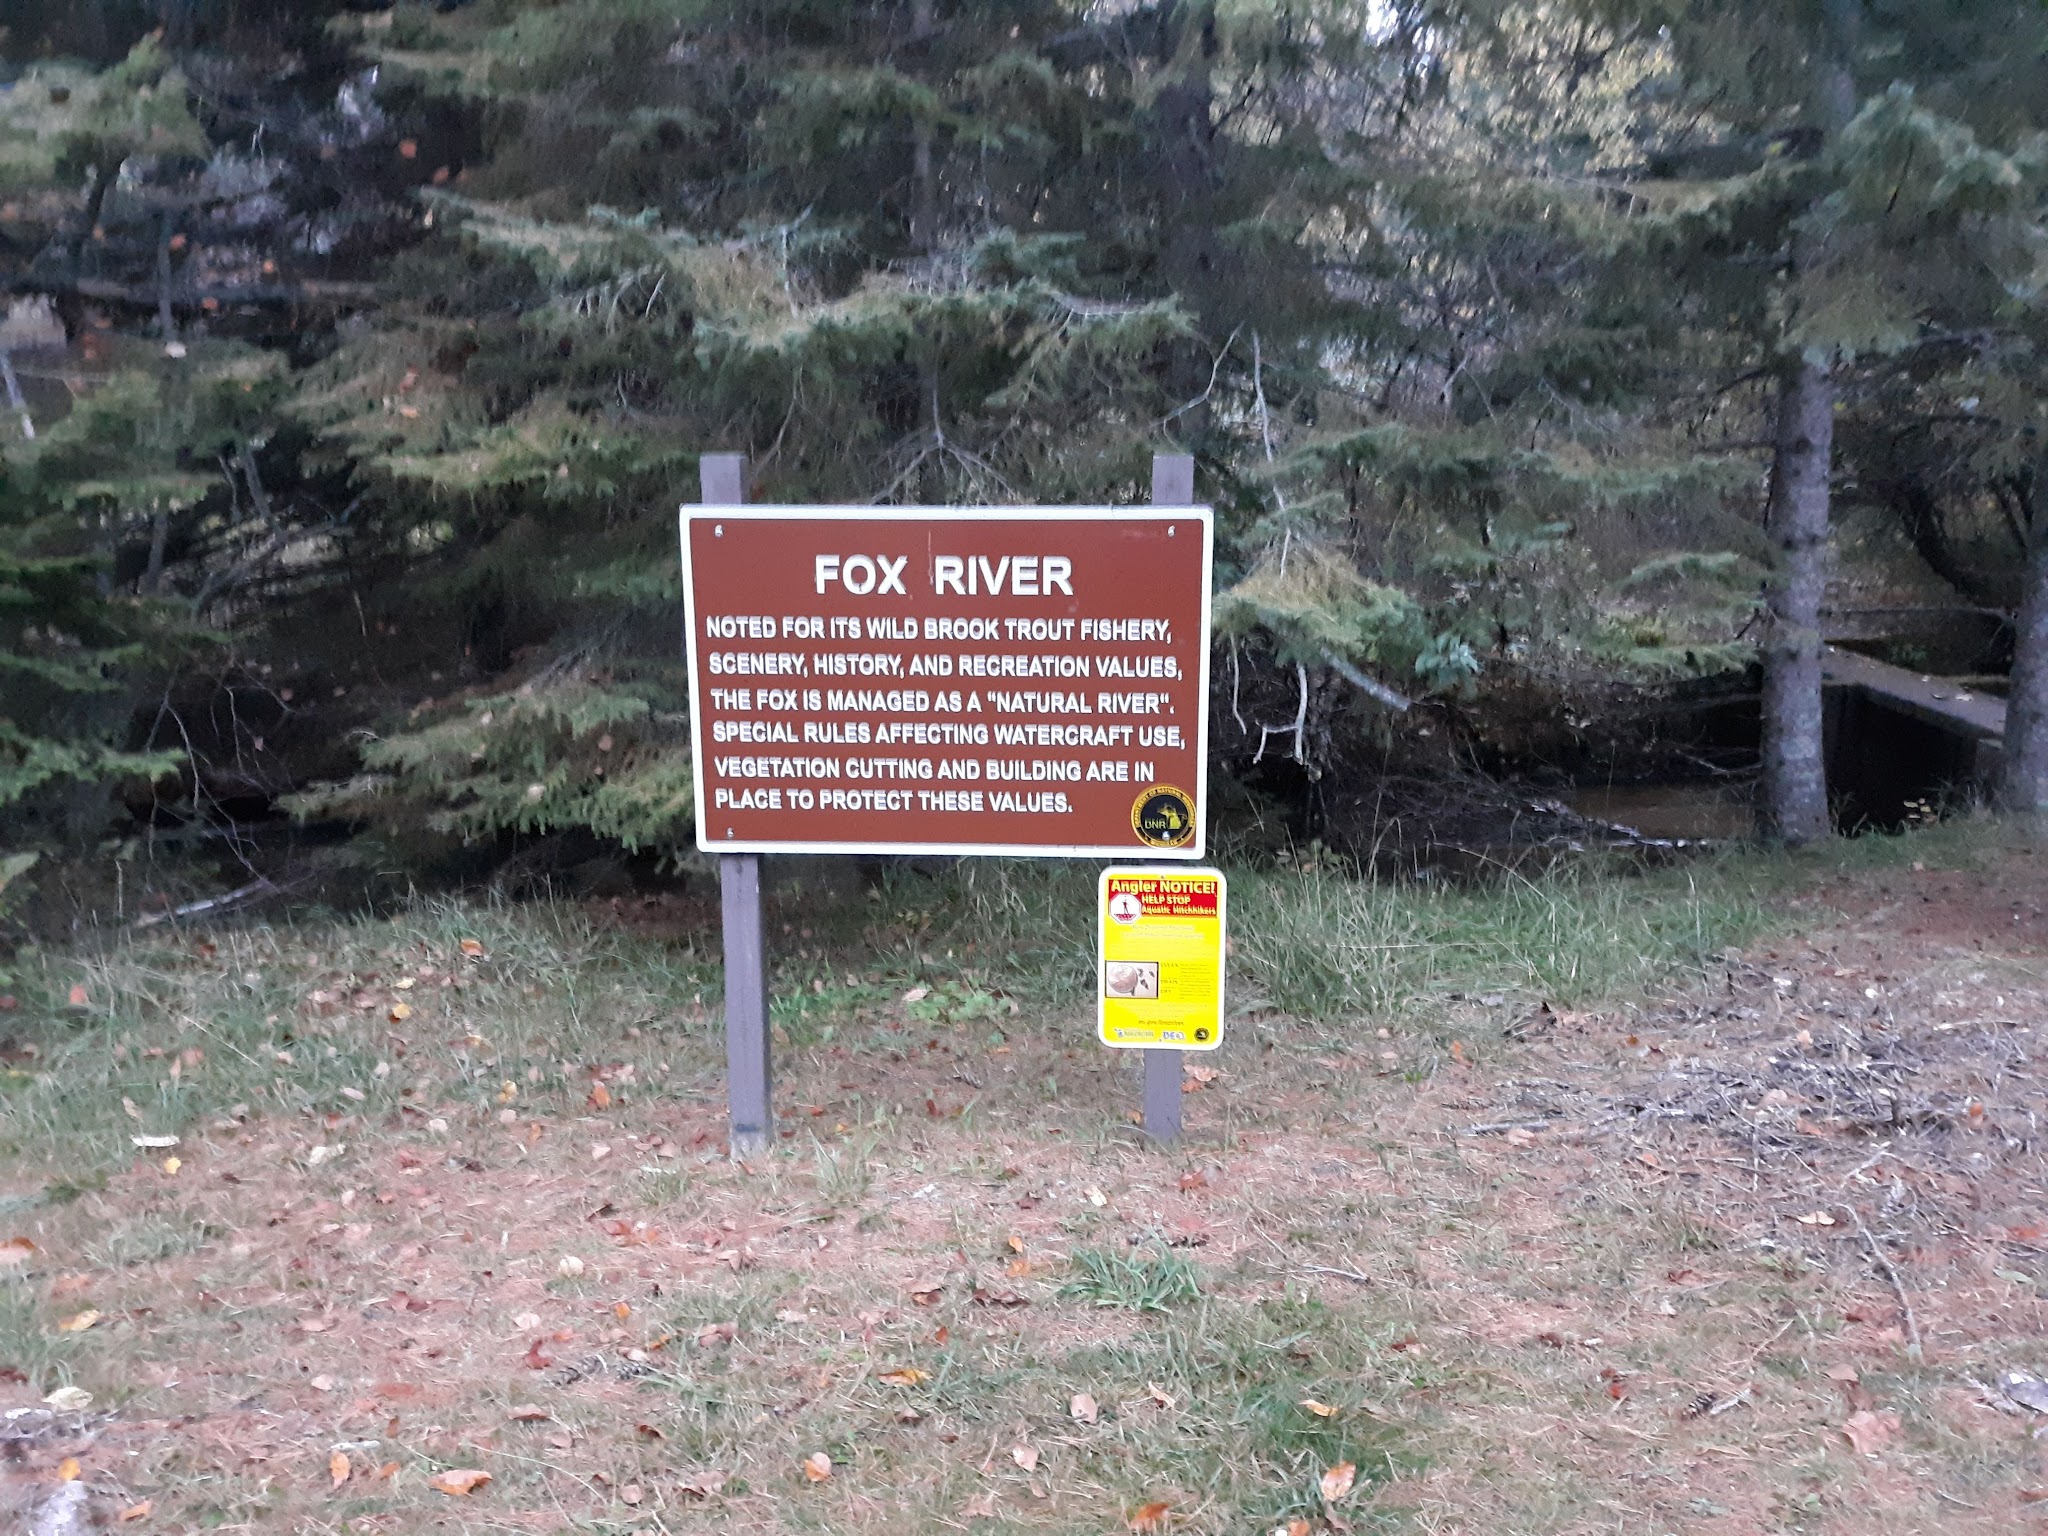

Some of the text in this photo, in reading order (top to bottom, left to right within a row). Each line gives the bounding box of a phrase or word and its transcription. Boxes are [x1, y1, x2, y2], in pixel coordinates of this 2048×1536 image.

[815, 555, 1073, 596] FOX RIVER
[707, 616, 1171, 644] NOTED FOR ITS WILD BROOK TROUT FISHERY,
[710, 652, 1182, 681] SCENERY, HISTORY, AND RECREATION VALUES,
[711, 689, 751, 710] THE
[757, 689, 798, 710] FOX
[803, 689, 821, 710] IS
[828, 690, 929, 711] MANAGED
[934, 691, 962, 712] AS
[967, 691, 982, 712] A
[987, 691, 1092, 713] "NATURAL
[713, 721, 1185, 750] SPECIAL RULES AFFECTING WATERCRAFT USE,
[714, 756, 1154, 782] VEGETATION CUTTING AND BUILDING ARE IN
[715, 788, 1073, 813] PLACE TO PROTECT THESE VALUES.
[1144, 819, 1166, 829] DNR
[1111, 880, 1216, 894] Angler NOTICE!
[1141, 895, 1191, 905] HELP STOP
[1141, 905, 1216, 915] Aquatic Hitchhikers
